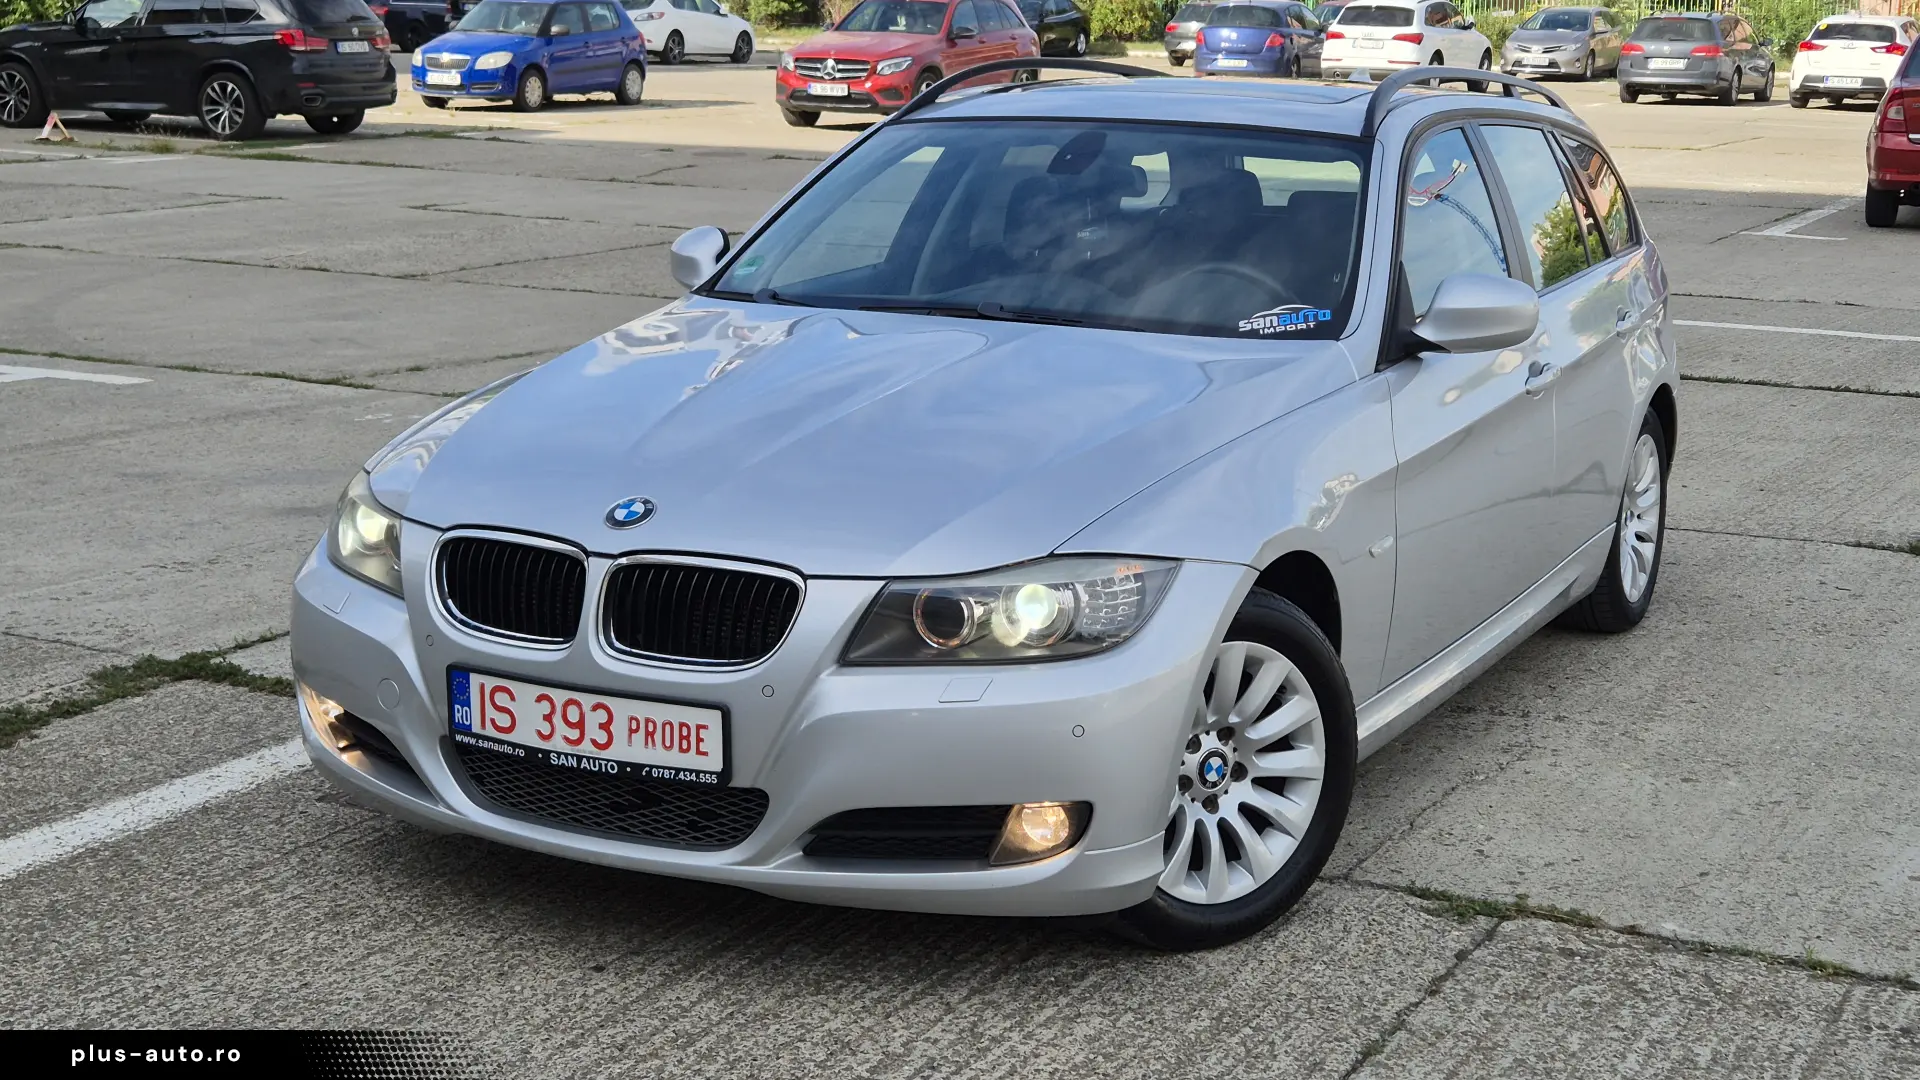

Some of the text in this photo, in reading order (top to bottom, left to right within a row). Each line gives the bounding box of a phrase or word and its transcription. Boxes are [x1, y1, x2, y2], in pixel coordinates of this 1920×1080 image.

[1259, 321, 1317, 335] IMPORT
[454, 704, 471, 726] RO
[479, 681, 709, 757] IS 393 PROBE
[455, 733, 718, 784] www.sanauto.ro SAN AUTO 0787.434.555
